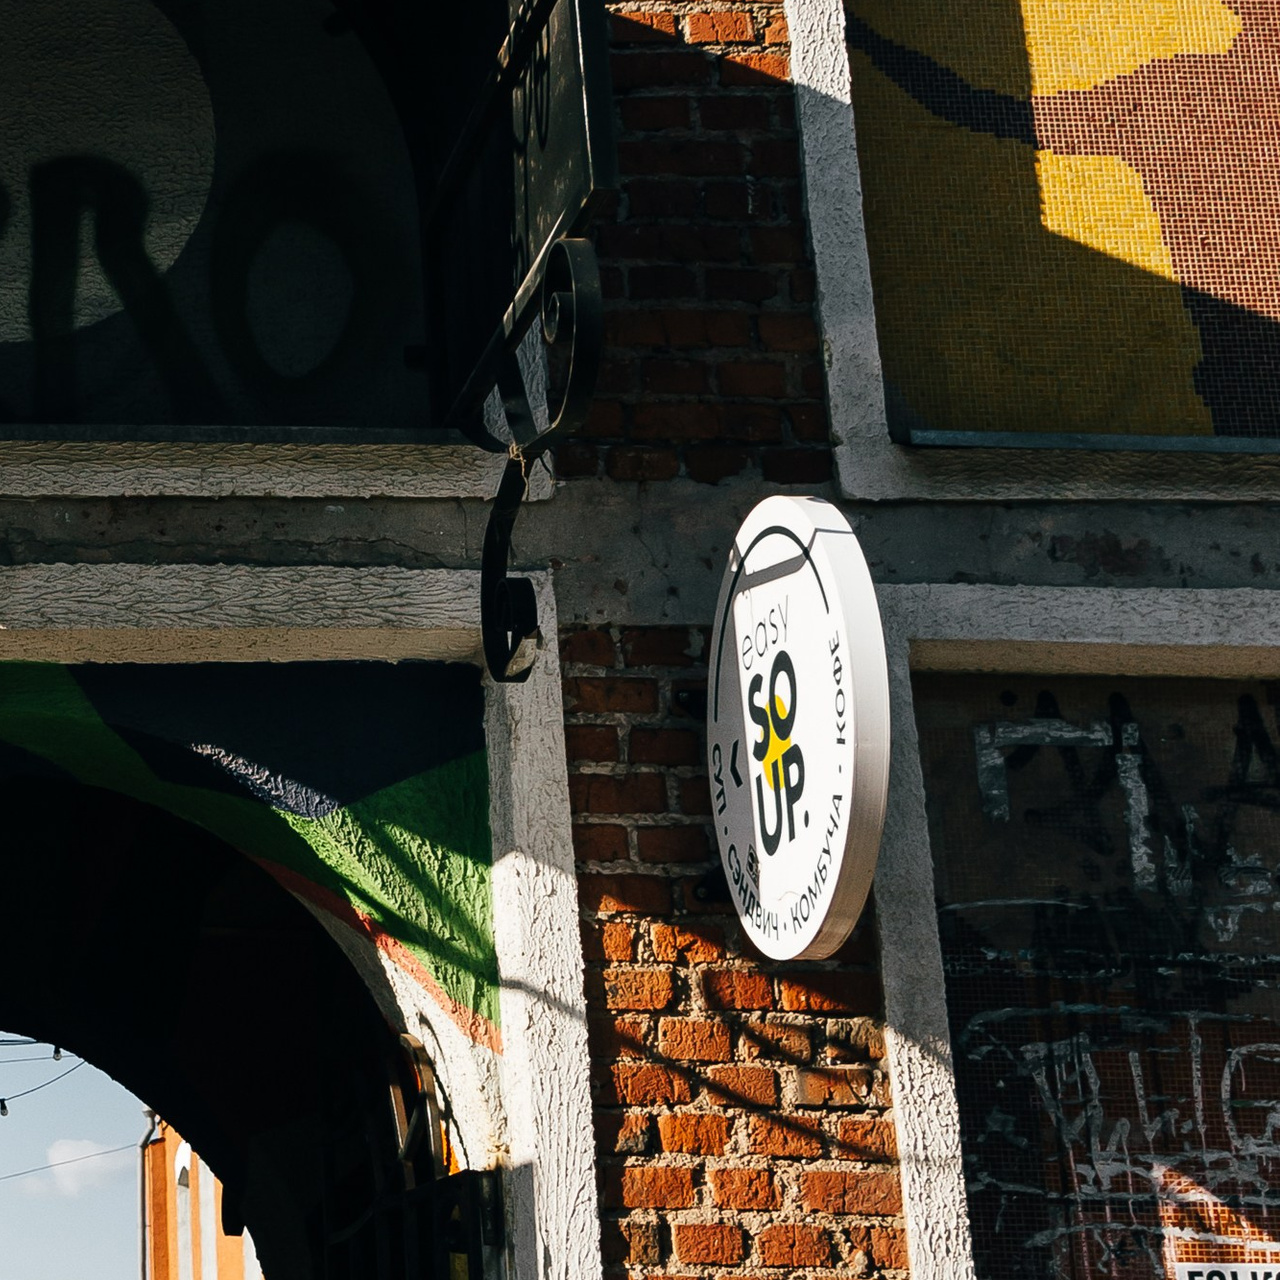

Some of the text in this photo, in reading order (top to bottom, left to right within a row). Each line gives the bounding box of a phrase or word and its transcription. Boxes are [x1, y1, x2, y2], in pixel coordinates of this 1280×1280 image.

[742, 594, 789, 670] easy
[748, 650, 797, 762] SO
[712, 630, 846, 941] СУП СЭНДВИЧ КОМБУЧА КОФЕ
